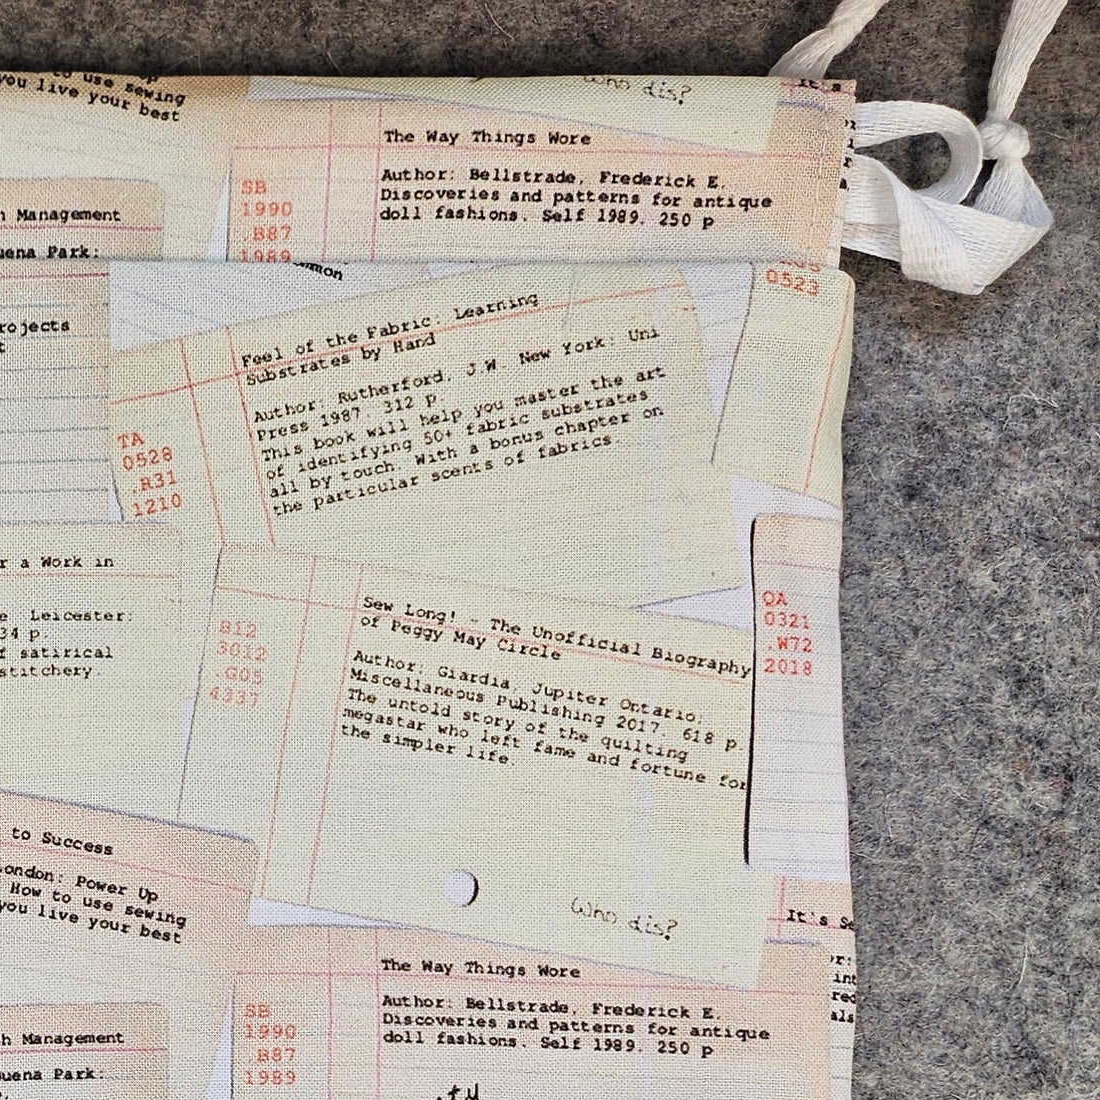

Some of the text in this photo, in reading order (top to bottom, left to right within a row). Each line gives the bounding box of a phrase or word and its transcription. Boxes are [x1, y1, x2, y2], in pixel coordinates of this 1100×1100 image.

[383, 128, 591, 147] The Way Things Wore
[599, 170, 695, 188] Frederick
[16, 208, 121, 224] Management
[241, 346, 283, 368] Feel
[295, 339, 314, 355] of
[325, 333, 358, 348] the
[453, 293, 538, 320] Learning
[261, 366, 666, 462] This book will help you master the art
[362, 596, 394, 611] Sew
[404, 603, 455, 625] Long!
[490, 617, 521, 635] The
[532, 625, 640, 656] Unofficial
[652, 646, 752, 681] Biography
[12, 827, 31, 841] to
[41, 831, 113, 856] Success
[75, 875, 127, 896] Power
[138, 886, 159, 905] Up
[38, 904, 79, 924] live
[87, 917, 131, 934] your
[139, 923, 181, 944] best
